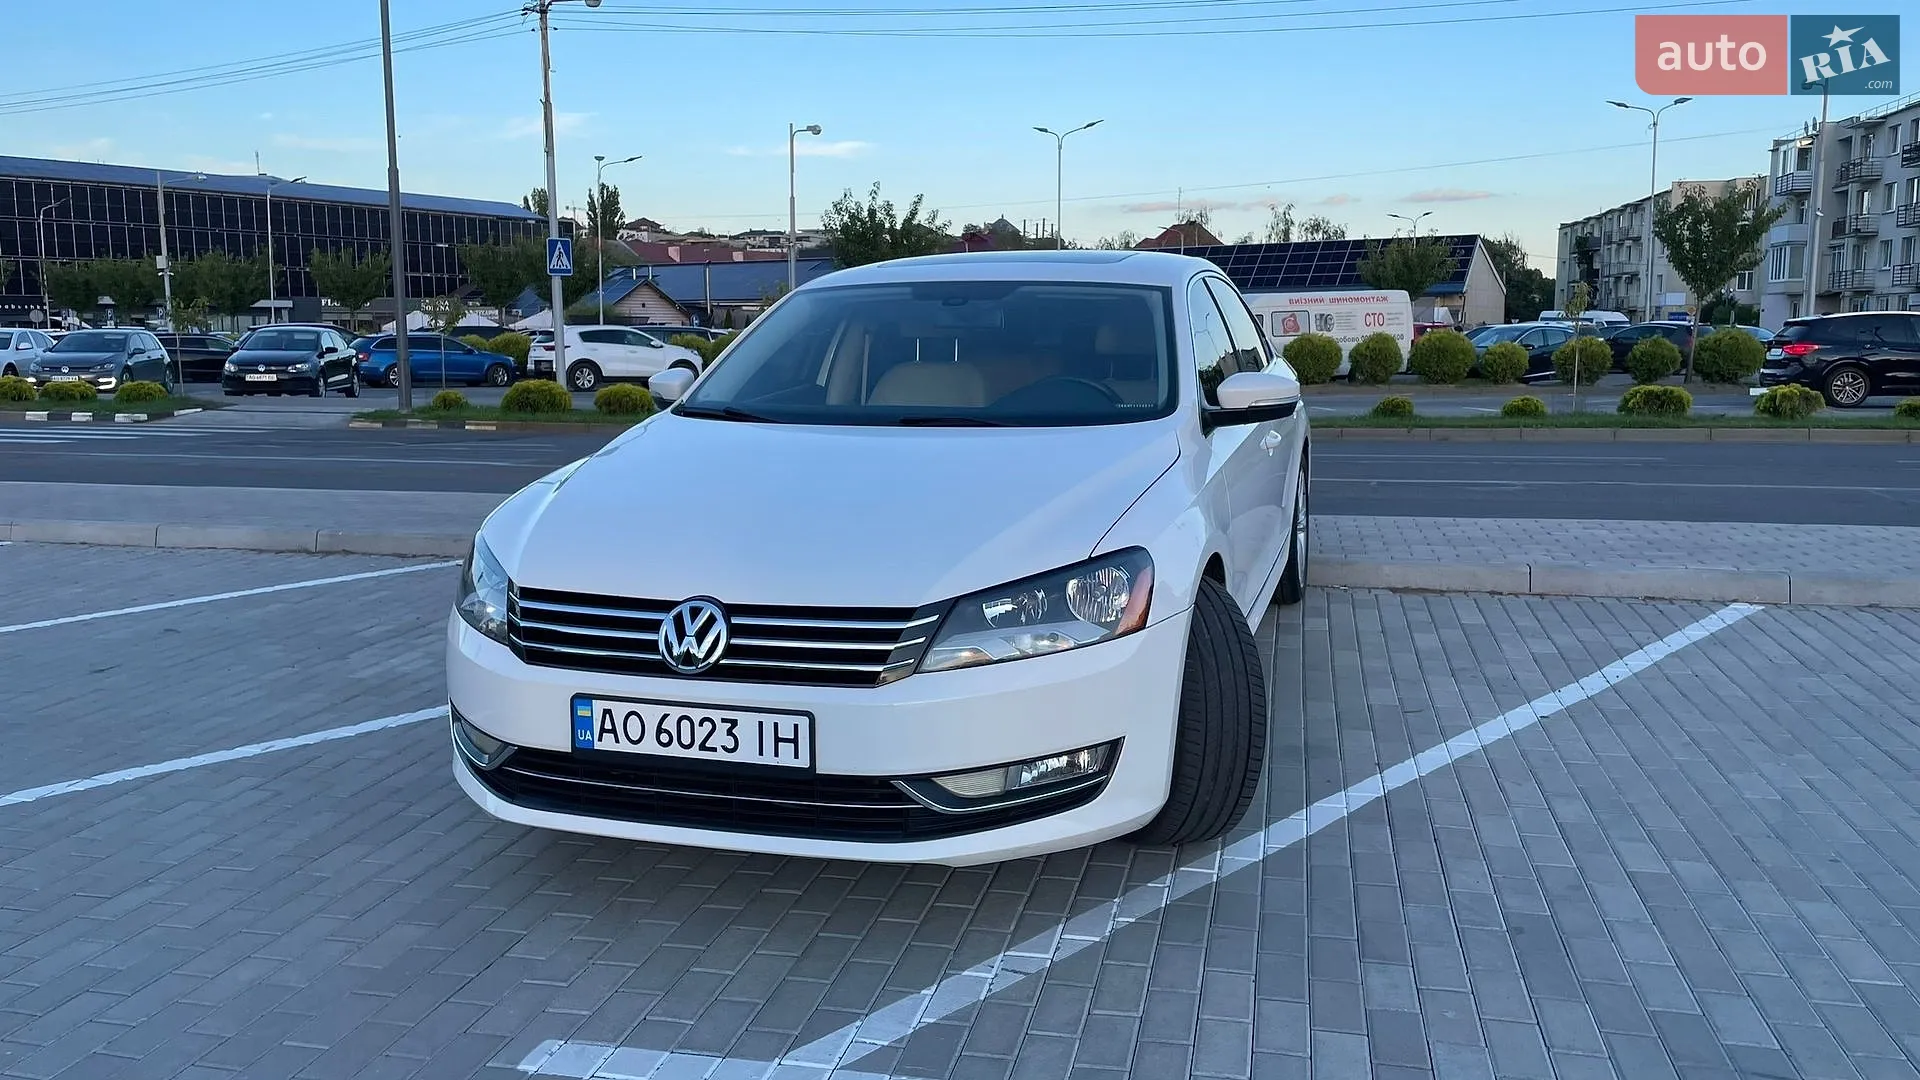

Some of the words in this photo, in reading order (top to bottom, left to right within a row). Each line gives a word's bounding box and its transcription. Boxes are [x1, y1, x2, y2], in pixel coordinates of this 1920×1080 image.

[1329, 295, 1389, 304] ШИНОМОНТАЖ
[1364, 312, 1385, 328] СТО
[577, 729, 593, 742] UA
[598, 708, 646, 745] AO
[655, 713, 740, 754] 6023
[757, 720, 800, 760] IH
